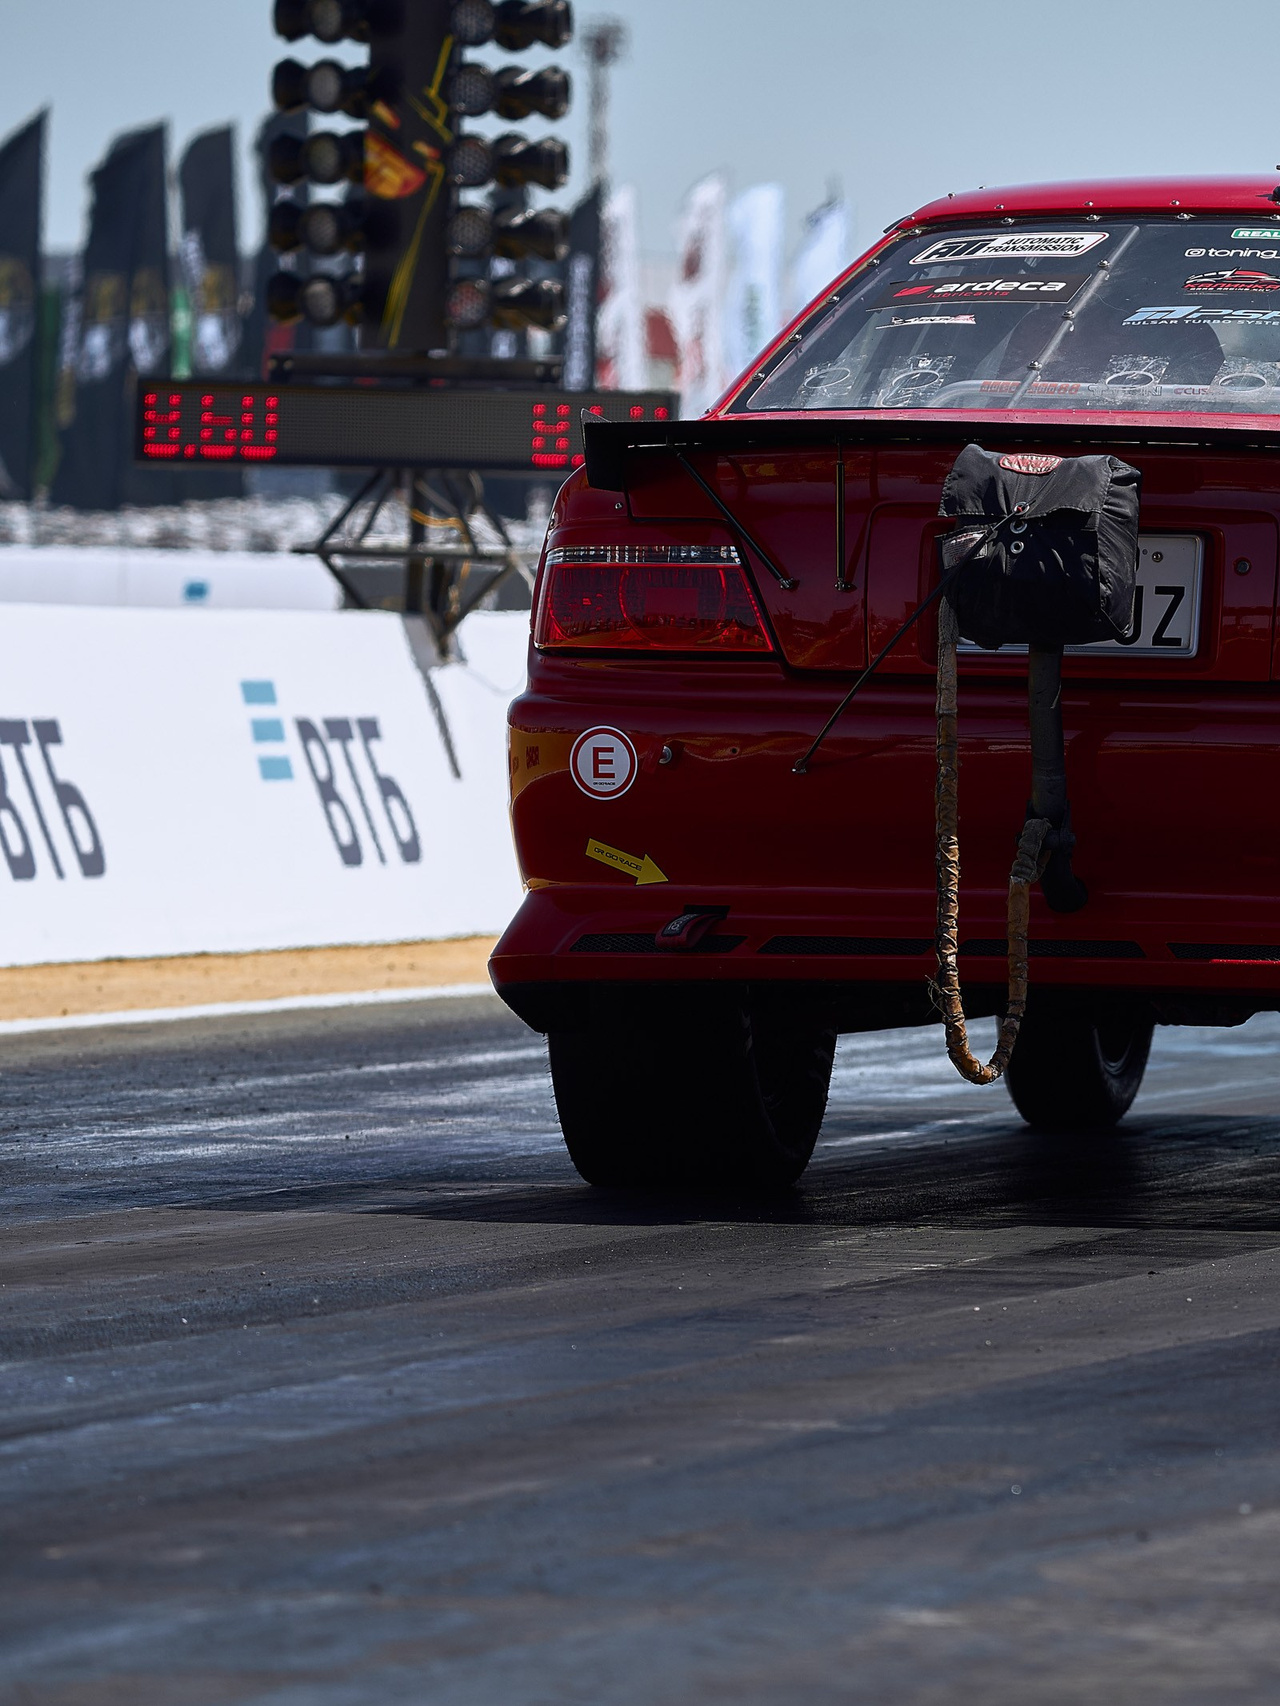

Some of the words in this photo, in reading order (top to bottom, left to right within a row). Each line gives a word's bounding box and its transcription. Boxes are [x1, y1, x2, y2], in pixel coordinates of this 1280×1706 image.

[1003, 236, 1084, 246] AUTOMATIC
[982, 244, 1086, 253] TRANSMISSION
[933, 278, 1067, 292] ardeca
[927, 290, 1011, 299] lubricants
[592, 747, 616, 779] E
[293, 716, 422, 868] ВТБ
